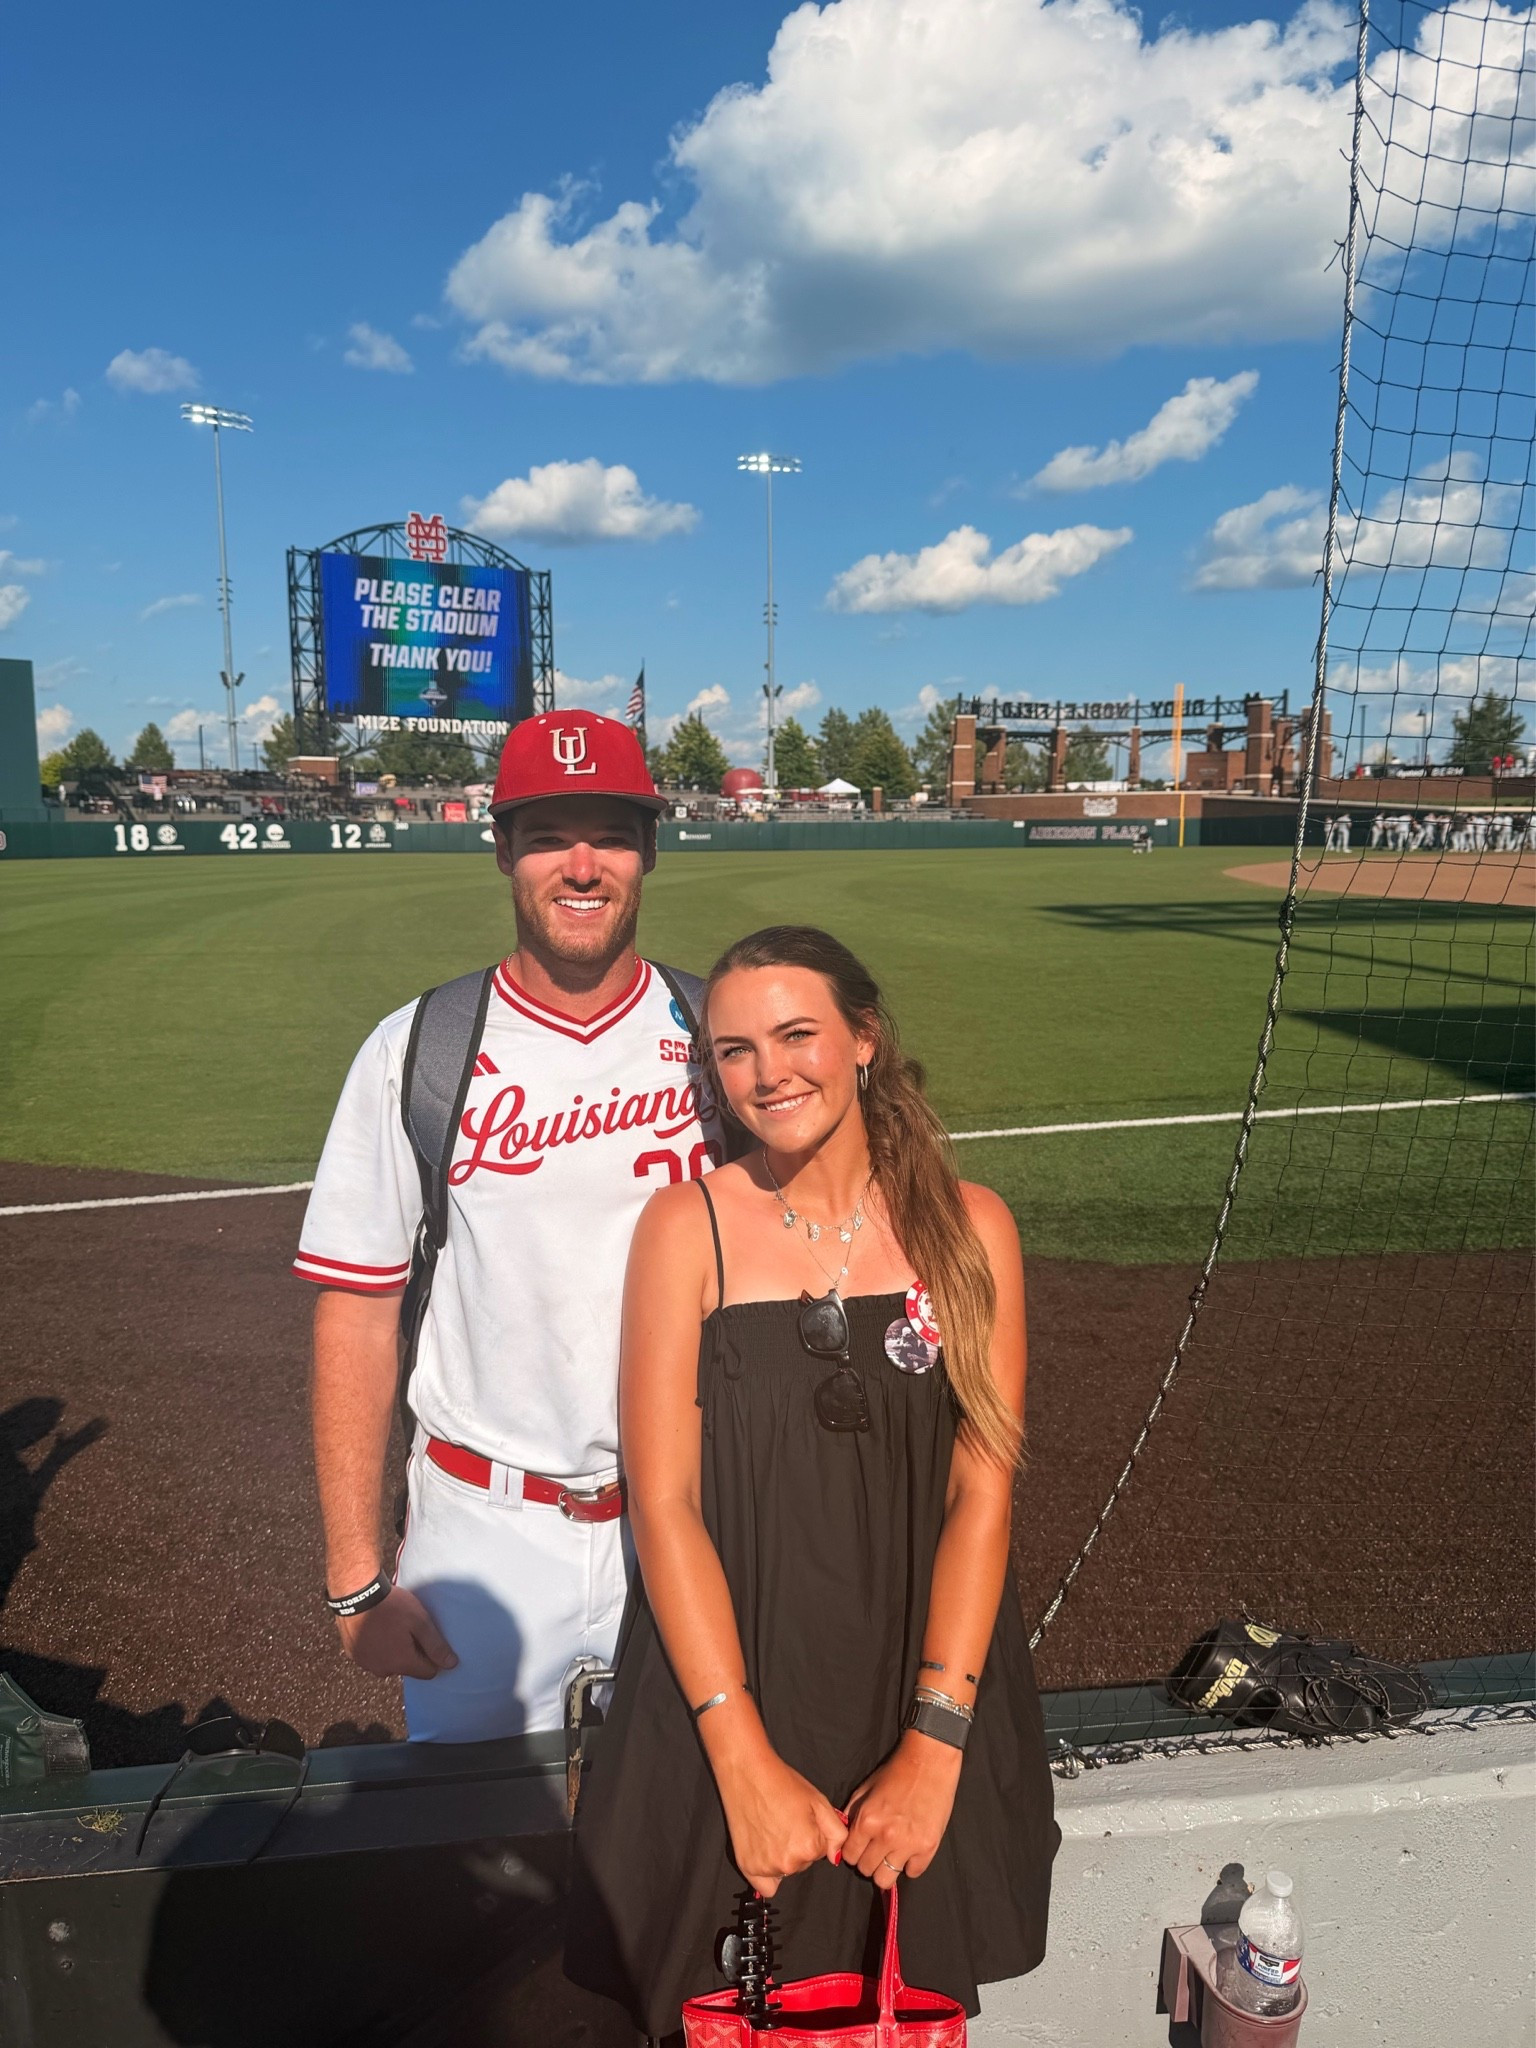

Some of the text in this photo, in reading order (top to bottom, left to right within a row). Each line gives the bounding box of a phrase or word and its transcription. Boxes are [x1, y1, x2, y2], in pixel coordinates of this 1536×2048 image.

[354, 577, 502, 613] PLEASE CLEAR
[361, 604, 499, 637] THE STADIUM
[370, 643, 493, 673] THANK YOU!
[357, 714, 509, 735] MIZE FOUNDATION
[114, 823, 149, 852] 18
[220, 823, 258, 850] 42
[330, 823, 362, 849] 12
[448, 1083, 717, 1186] Louisiana
